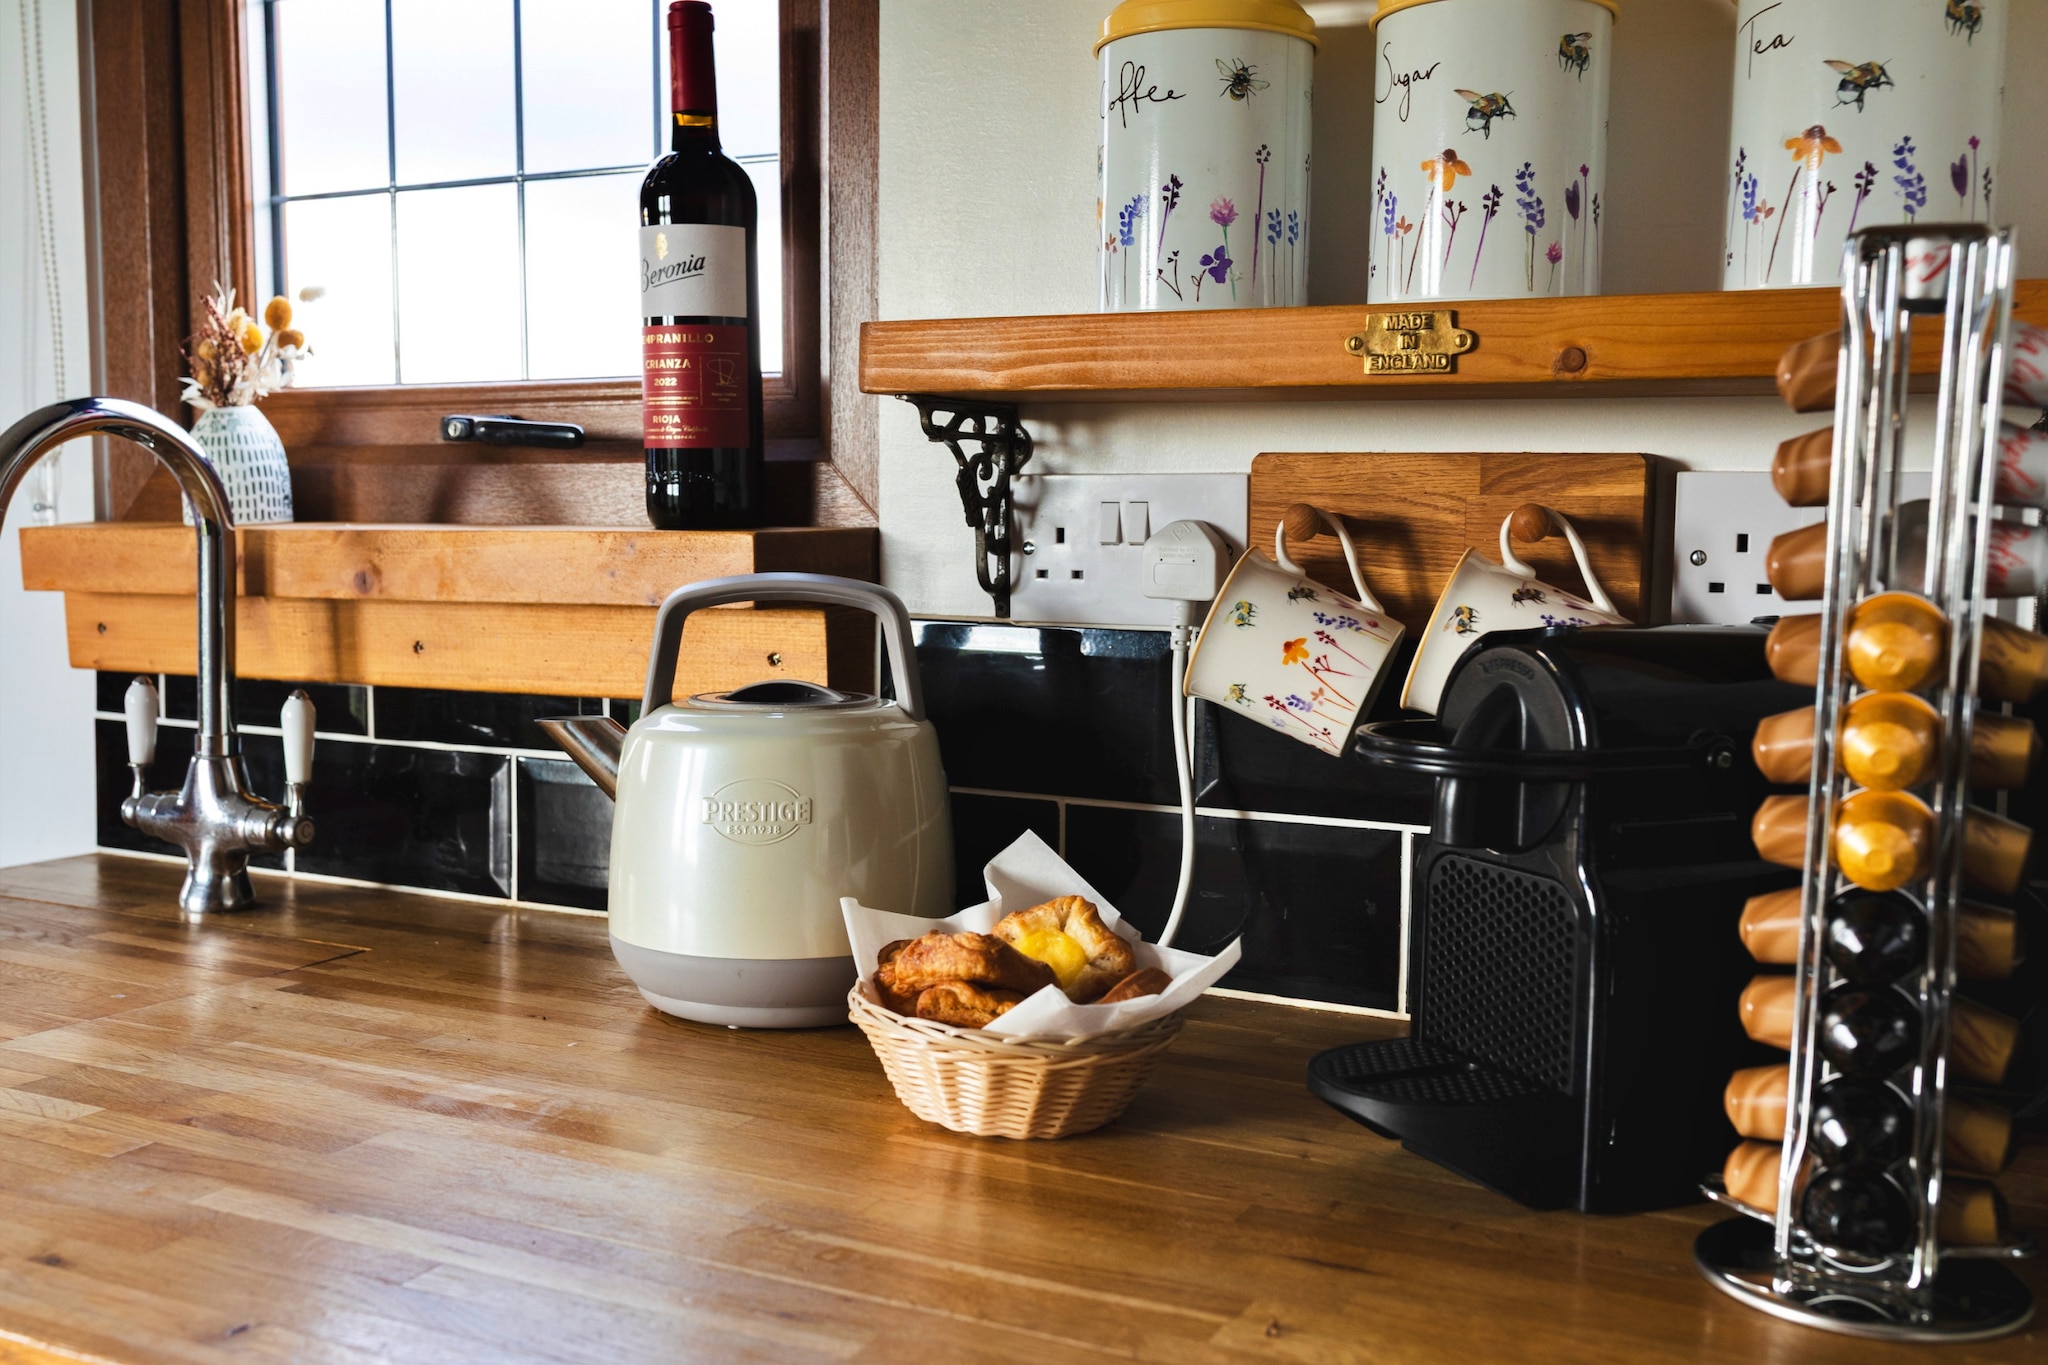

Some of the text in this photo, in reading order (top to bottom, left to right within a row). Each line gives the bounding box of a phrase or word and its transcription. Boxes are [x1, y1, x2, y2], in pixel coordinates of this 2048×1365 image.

[1739, 2, 1795, 79] Tea
[1375, 41, 1441, 122] Sugar
[1384, 314, 1434, 331] MADE
[1399, 332, 1418, 349] IN
[645, 358, 691, 369] CRIANZA
[1369, 353, 1449, 370] ENGLAND
[654, 377, 678, 387] 2022
[652, 415, 681, 425] RIOJA
[706, 800, 809, 822] PRESTIGE
